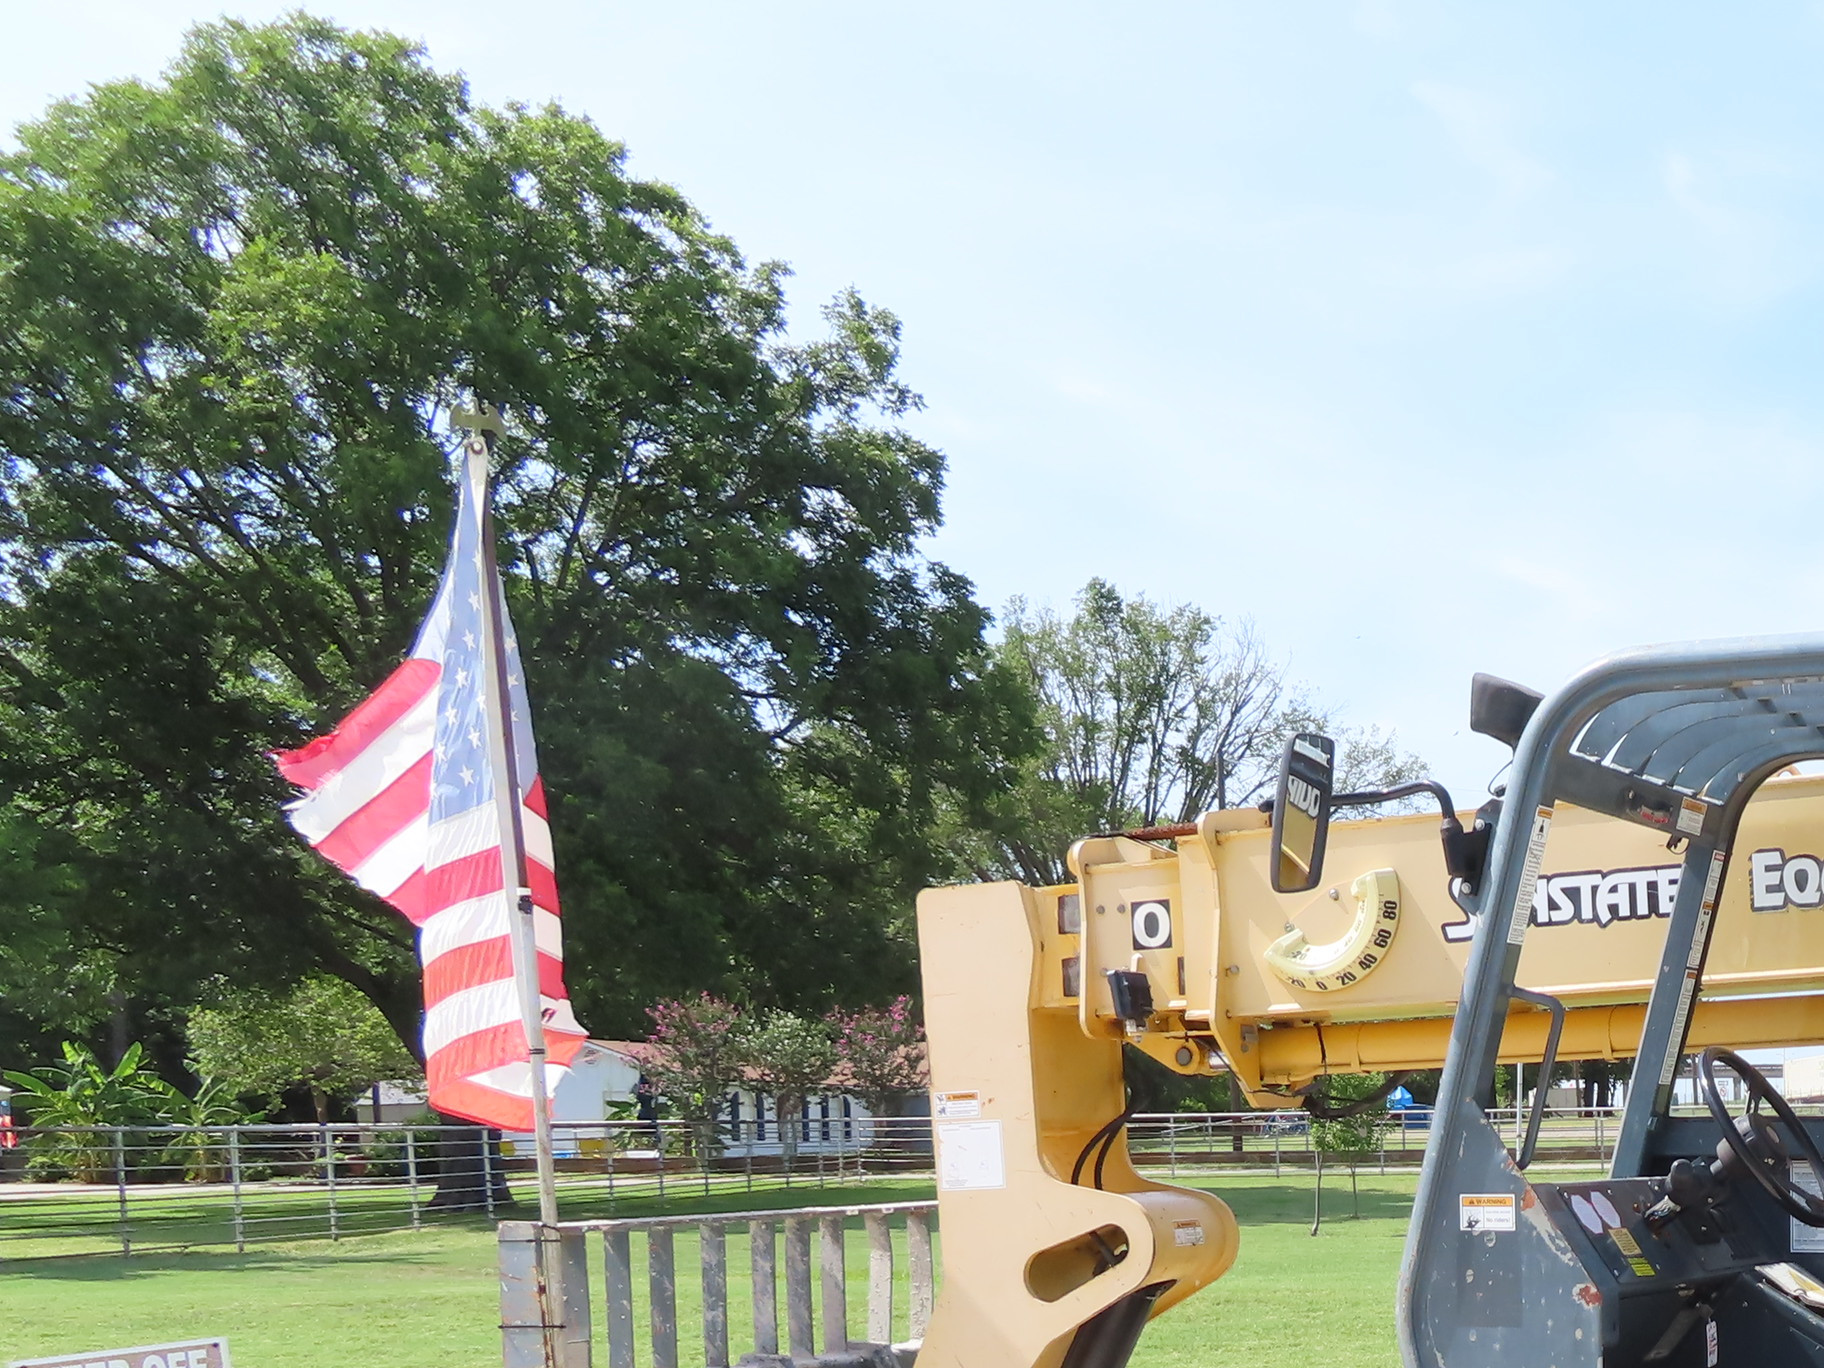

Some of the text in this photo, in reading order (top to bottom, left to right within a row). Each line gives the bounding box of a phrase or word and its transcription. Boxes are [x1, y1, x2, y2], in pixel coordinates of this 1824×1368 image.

[1336, 971, 1357, 986] 20
[1358, 953, 1378, 971] 40
[1374, 929, 1392, 948] 60
[1383, 900, 1397, 920] 80
